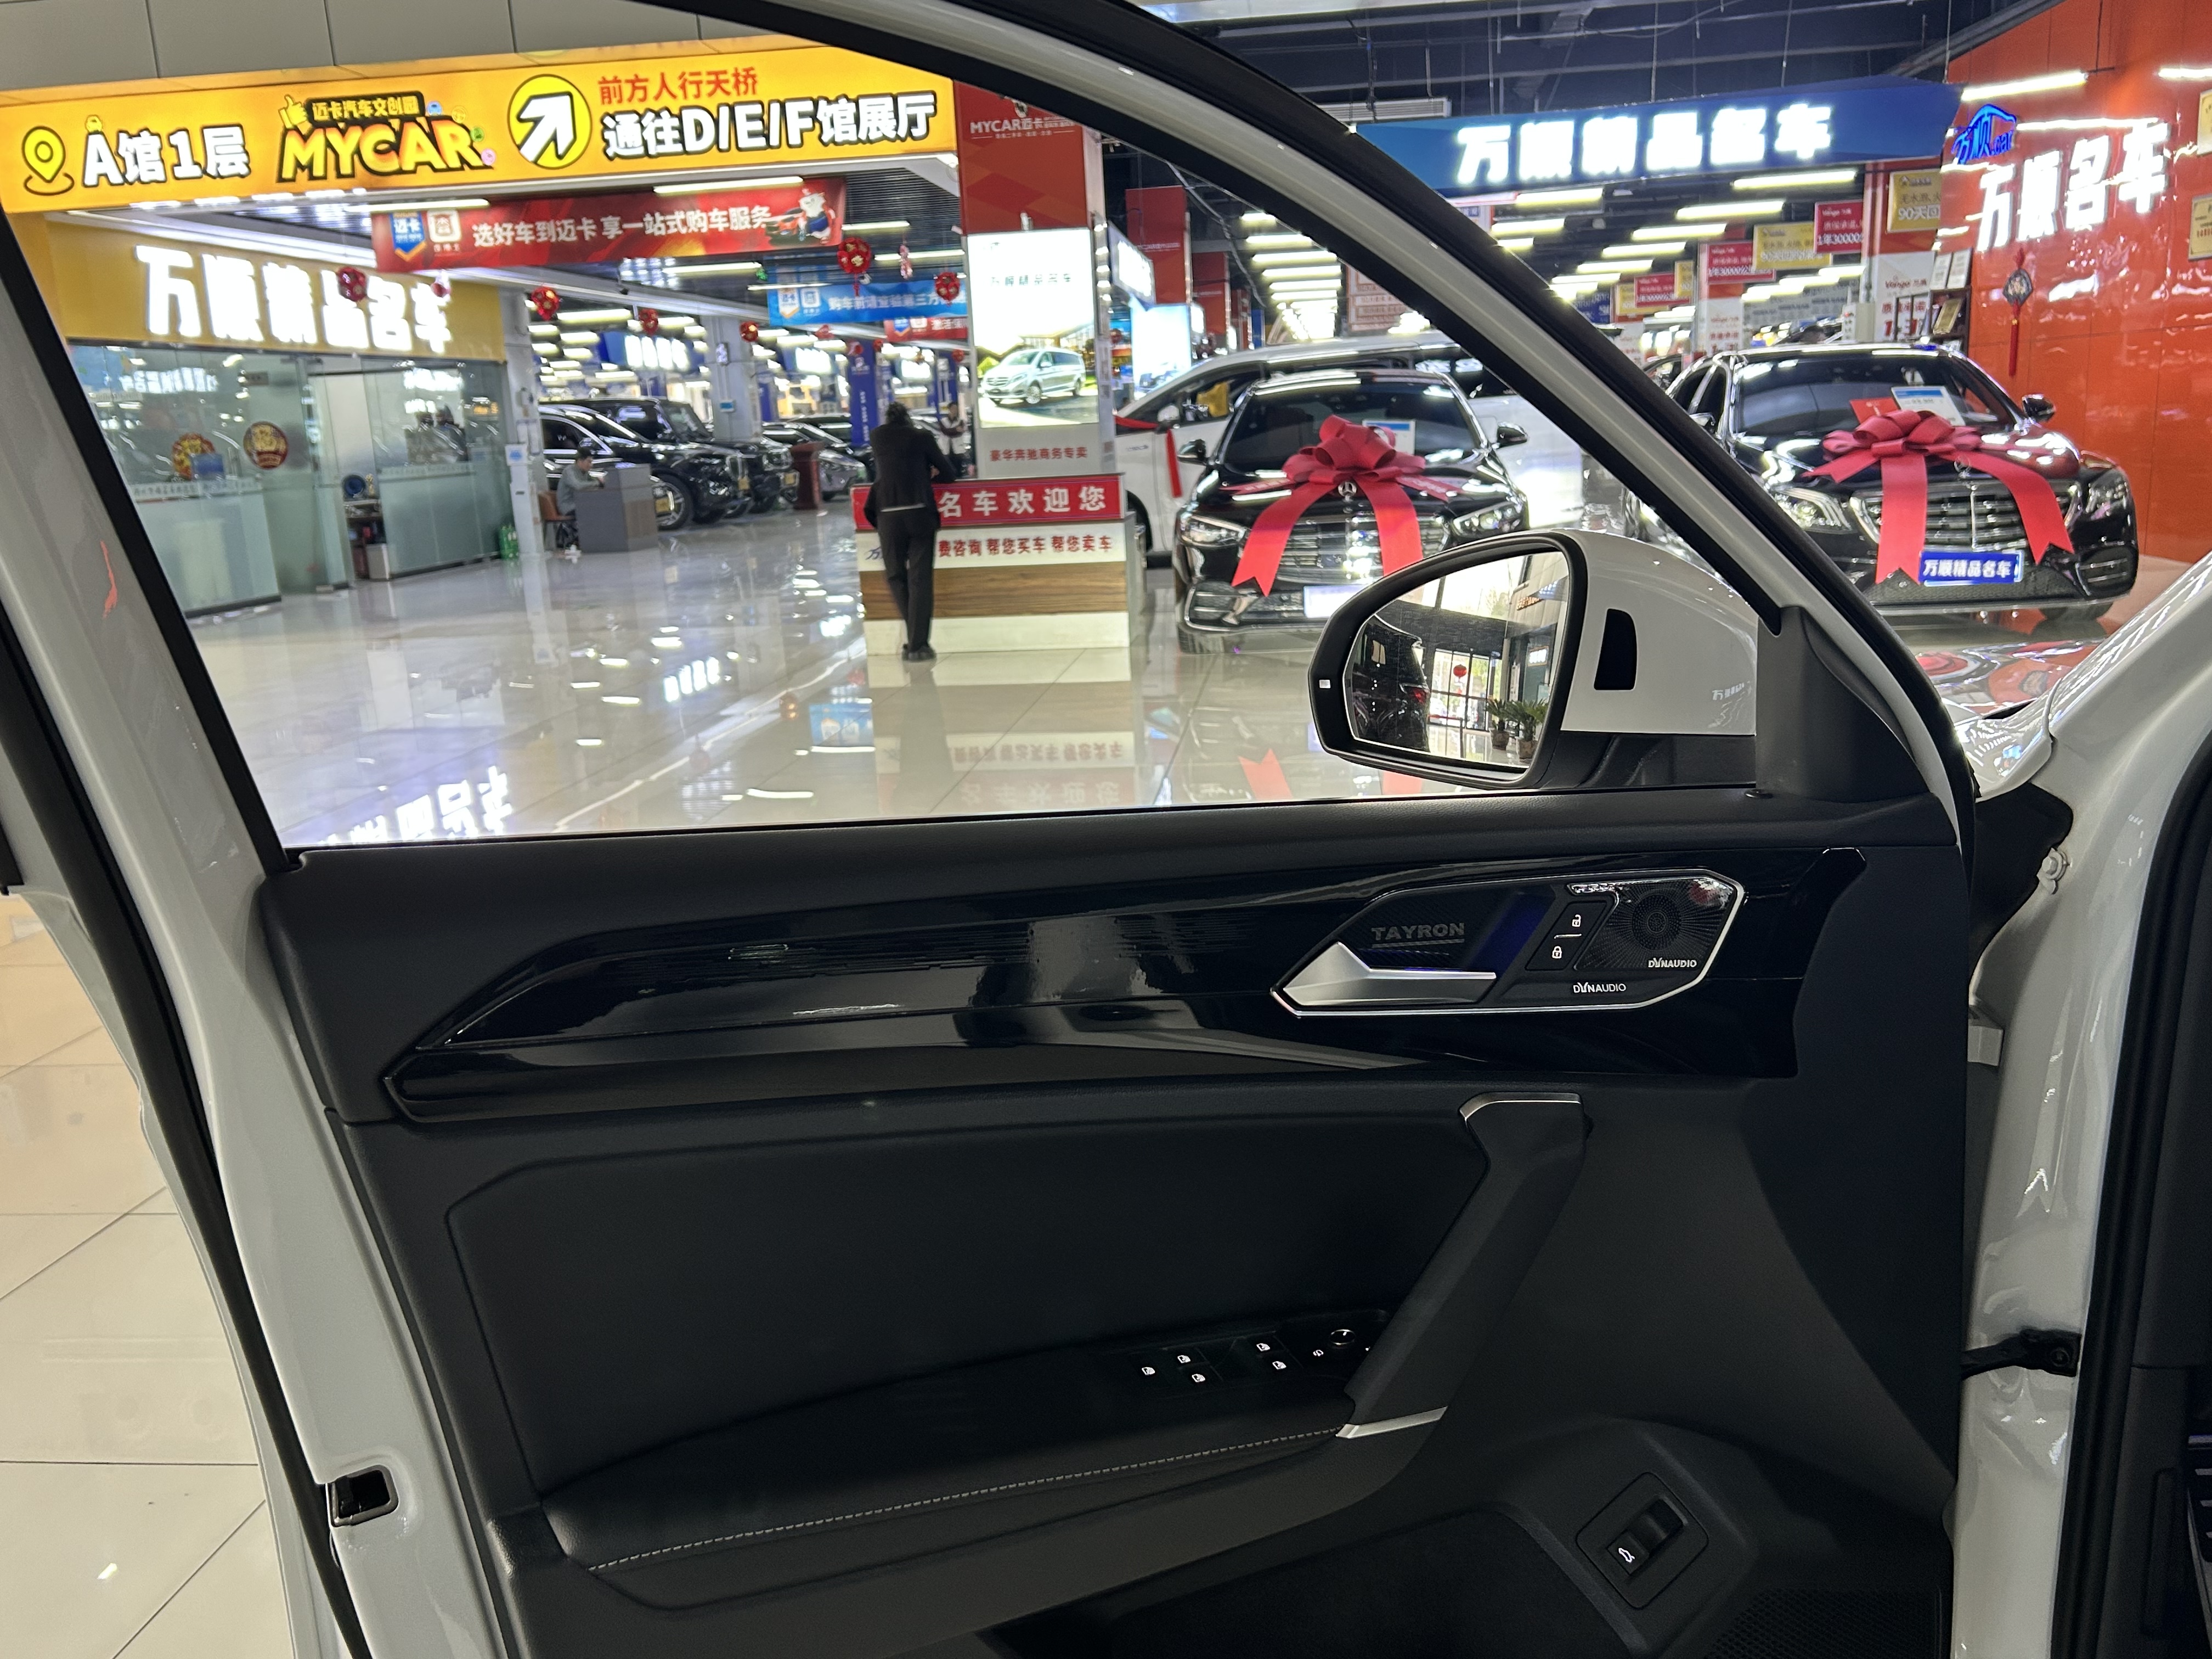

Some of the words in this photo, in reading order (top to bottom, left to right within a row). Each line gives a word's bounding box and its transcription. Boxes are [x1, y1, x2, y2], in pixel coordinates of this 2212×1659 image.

[598, 66, 758, 105] 前方人行天桥
[312, 95, 420, 120] 迈卡汽车文创园
[83, 125, 250, 187] A馆1层
[278, 117, 484, 182] MYCAR
[472, 218, 597, 247] 选好车到迈卡
[601, 204, 772, 241] 享一站式购车服务
[990, 447, 1087, 461] 豪华奔驰商务专卖
[987, 537, 1046, 556] 帮您买车
[1051, 534, 1113, 554] 帮您卖车
[1923, 559, 2011, 578] 万顺精品名车
[1372, 922, 1464, 941] TAYRON
[1647, 957, 1697, 968] DYNAUDIO
[1573, 982, 1627, 993] DYNAUDIO
